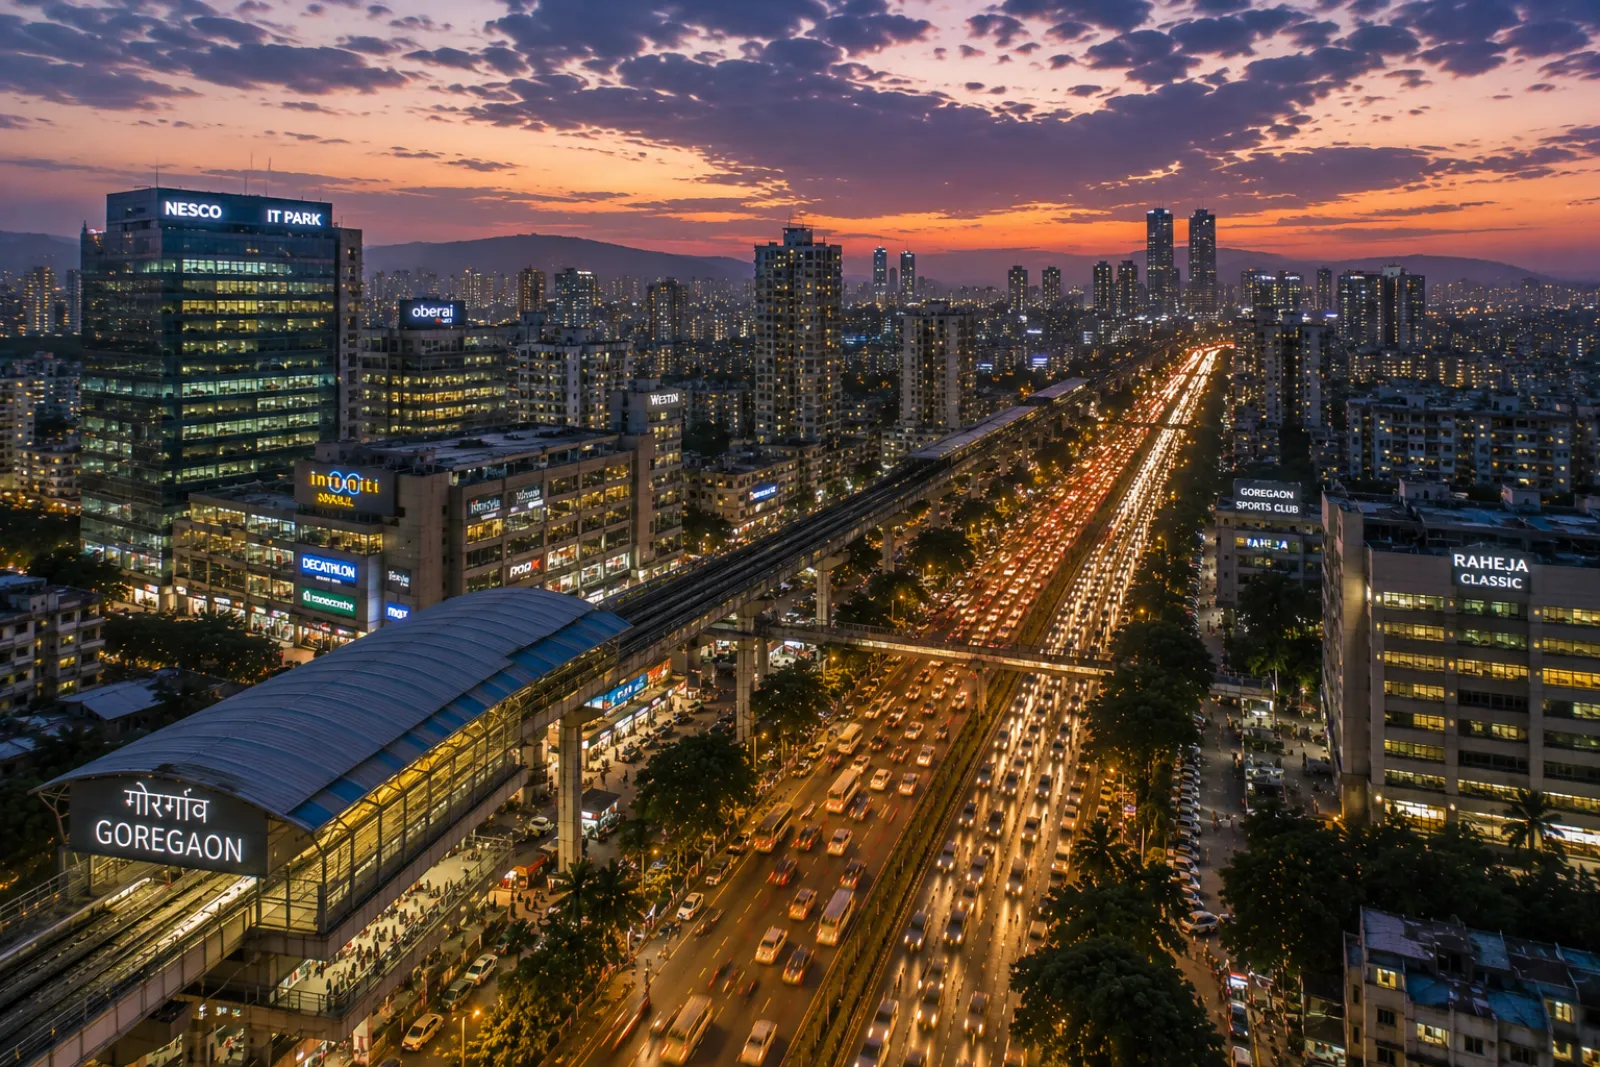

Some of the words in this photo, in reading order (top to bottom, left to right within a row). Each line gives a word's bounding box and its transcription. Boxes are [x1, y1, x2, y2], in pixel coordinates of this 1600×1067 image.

[164, 200, 222, 219] NESCO
[266, 209, 282, 223] IT
[284, 210, 321, 226] PARK
[412, 304, 453, 318] oberai
[1240, 487, 1294, 499] GOREGAON
[1236, 501, 1272, 512] SPORTS
[1274, 503, 1299, 514] CLUB
[302, 556, 355, 578] DECATHLON
[1453, 553, 1529, 573] RAHEJA
[1460, 573, 1523, 589] CLASSIC
[95, 819, 242, 863] GOREGAON
